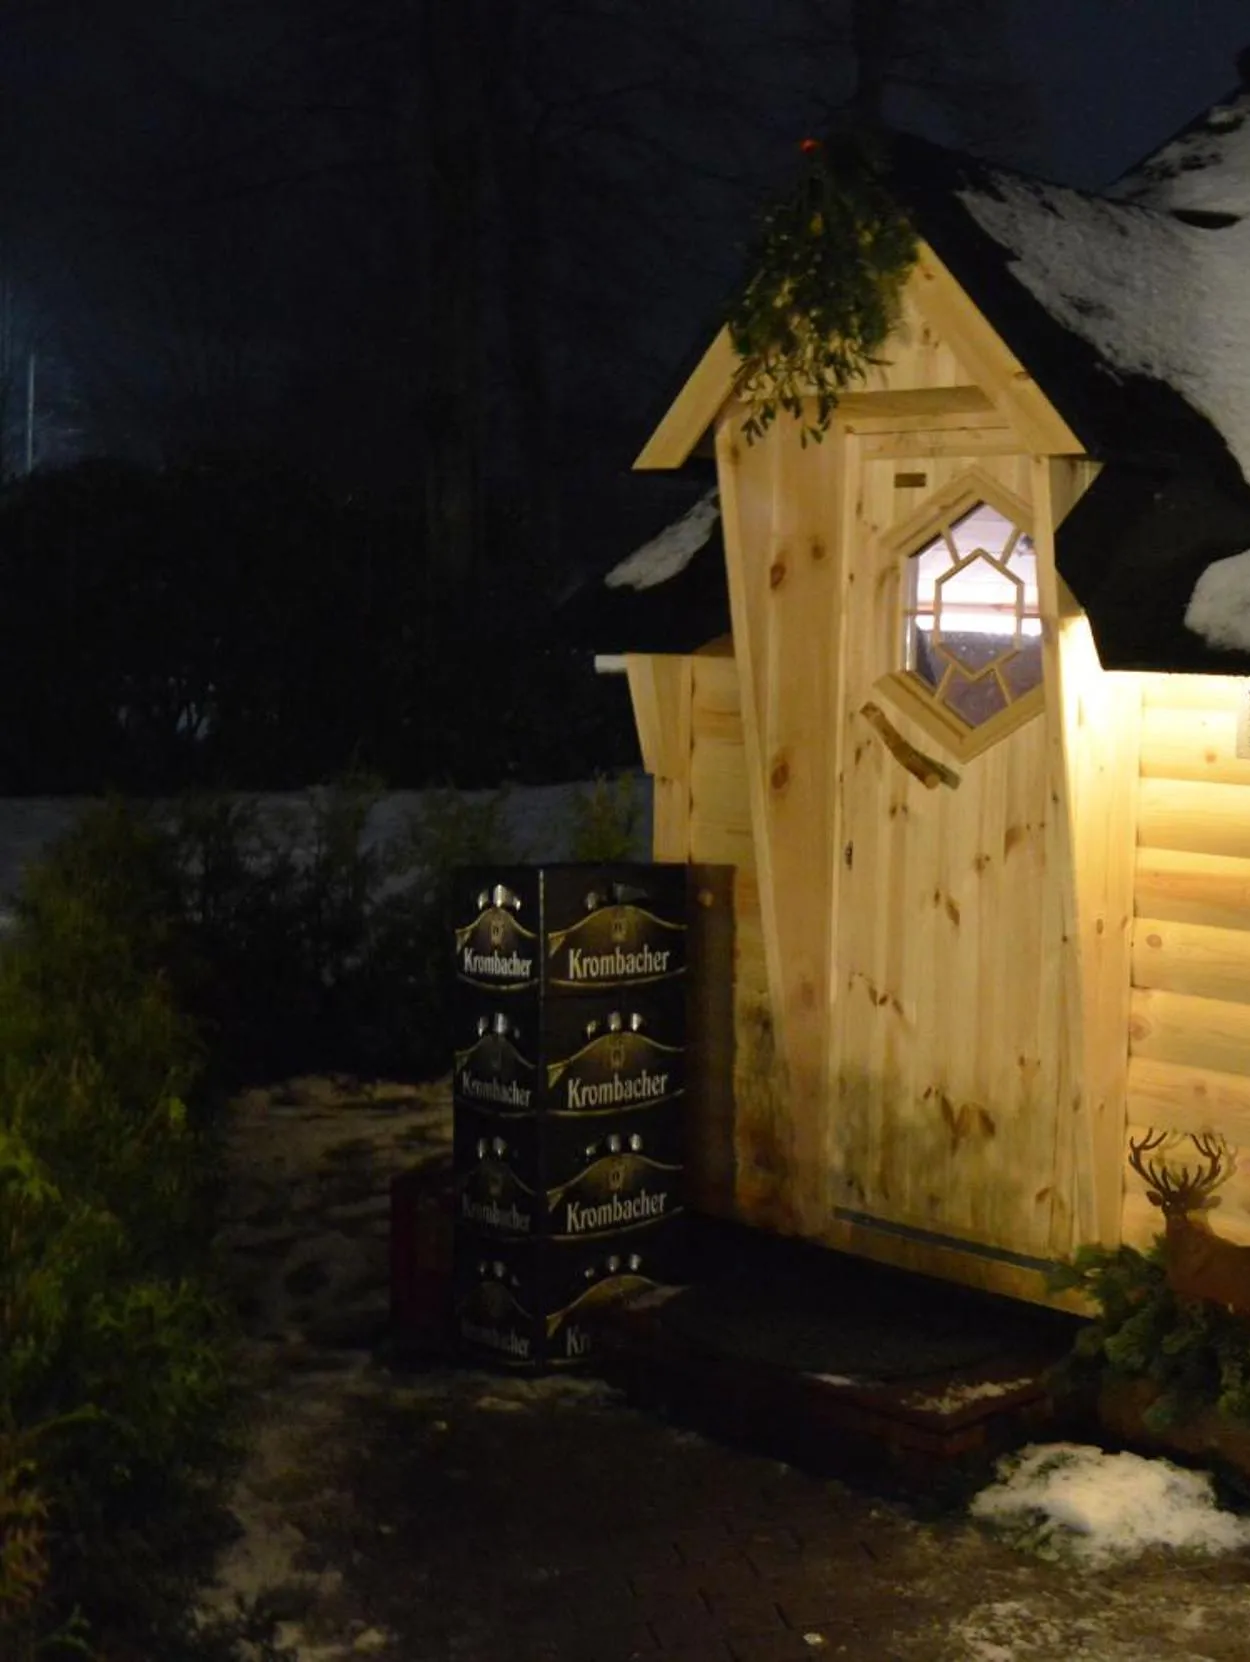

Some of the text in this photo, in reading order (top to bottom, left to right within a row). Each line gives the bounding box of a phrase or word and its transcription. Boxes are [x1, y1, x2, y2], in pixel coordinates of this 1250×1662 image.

[464, 947, 532, 977] Krombacher
[569, 943, 670, 979] Krombacher
[567, 1069, 669, 1109] Krombacher
[566, 1189, 667, 1232] Krombacher
